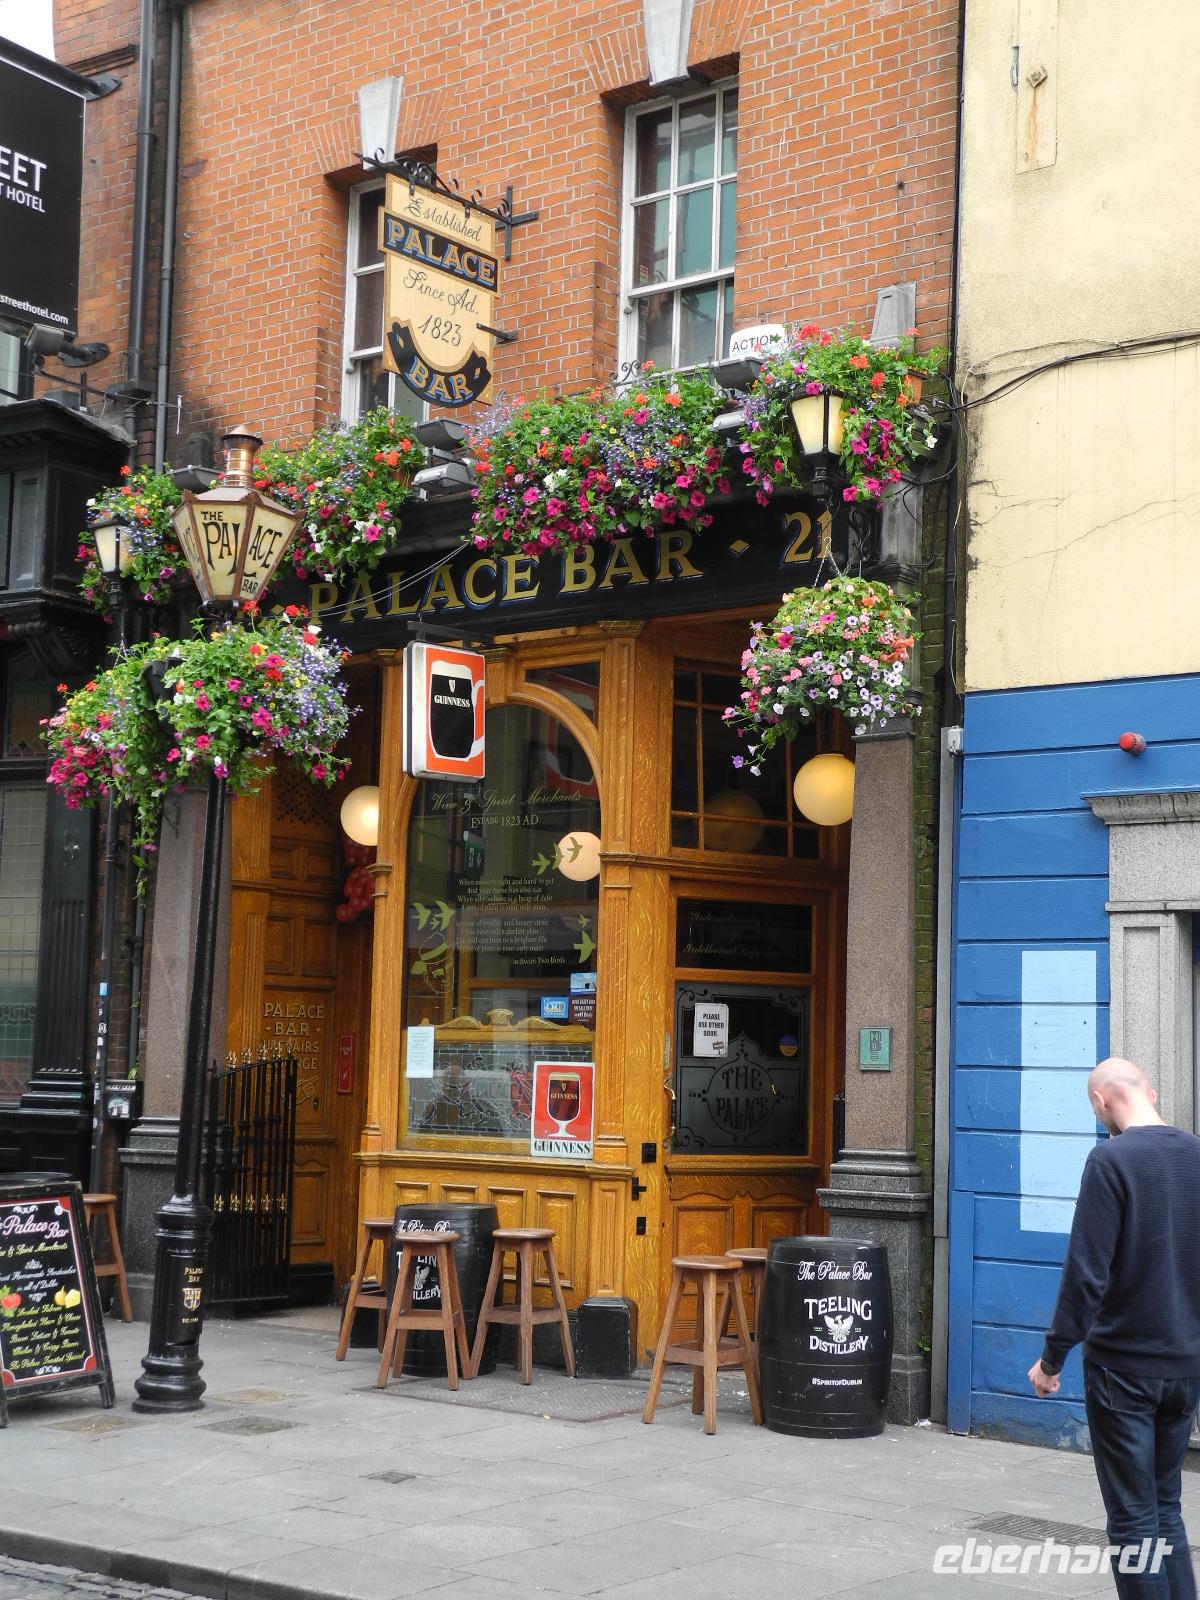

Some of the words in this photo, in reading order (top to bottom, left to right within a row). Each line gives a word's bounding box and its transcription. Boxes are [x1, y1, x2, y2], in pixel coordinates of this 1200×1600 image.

[7, 186, 46, 213] HOTEL
[403, 197, 481, 242] Established
[386, 218, 496, 287] PALACE
[403, 269, 445, 301] Since
[447, 288, 479, 316] Ad.
[418, 314, 462, 347] 1823
[405, 355, 475, 404] BAR
[201, 510, 223, 521] THE
[202, 521, 282, 578] PALACE
[779, 509, 833, 569] 21
[241, 579, 258, 594] BAR
[308, 552, 542, 626] PALACE
[559, 529, 705, 593] BAR
[434, 695, 470, 708] GUINNESS
[432, 792, 456, 811] Wine
[521, 786, 582, 806] Merchants
[501, 815, 521, 827] 1823
[522, 814, 539, 826] AD
[263, 1002, 325, 1019] PALACE
[274, 1021, 310, 1036] BAR
[722, 1065, 763, 1091] THE
[716, 1096, 769, 1131] PALACE
[534, 1140, 591, 1154] GUINNESS
[3, 1214, 48, 1236] Palace
[44, 1220, 70, 1239] Bar
[34, 1240, 68, 1253] Merchants
[396, 1251, 438, 1269] TLIN
[798, 1260, 816, 1280] The
[818, 1260, 850, 1280] Palace
[852, 1260, 873, 1280] Bar
[413, 1284, 441, 1300] ILLERY
[804, 1296, 872, 1320] TEELING
